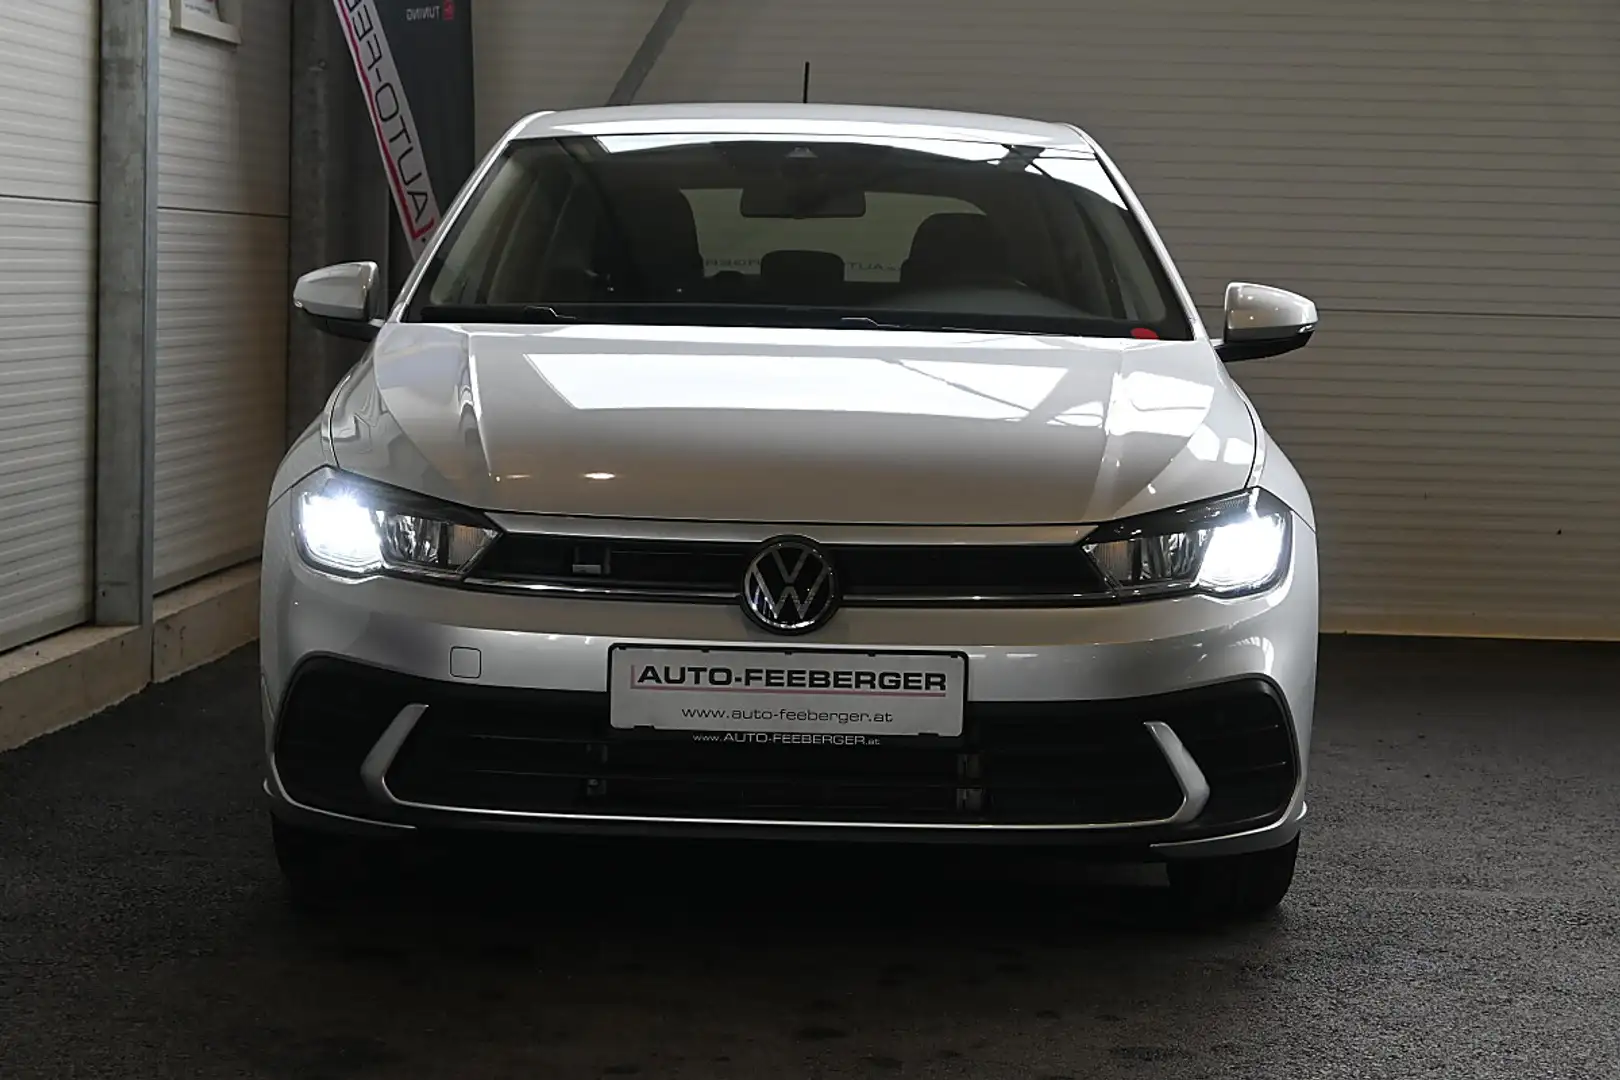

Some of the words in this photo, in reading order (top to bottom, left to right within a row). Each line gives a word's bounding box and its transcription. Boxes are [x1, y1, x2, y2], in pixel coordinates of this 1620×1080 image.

[637, 665, 947, 691] AUTO-FEEBERGER
[681, 707, 894, 724] www.auto-feeberger.at
[692, 732, 881, 746] www.AUTO-FEEBERGER.at
